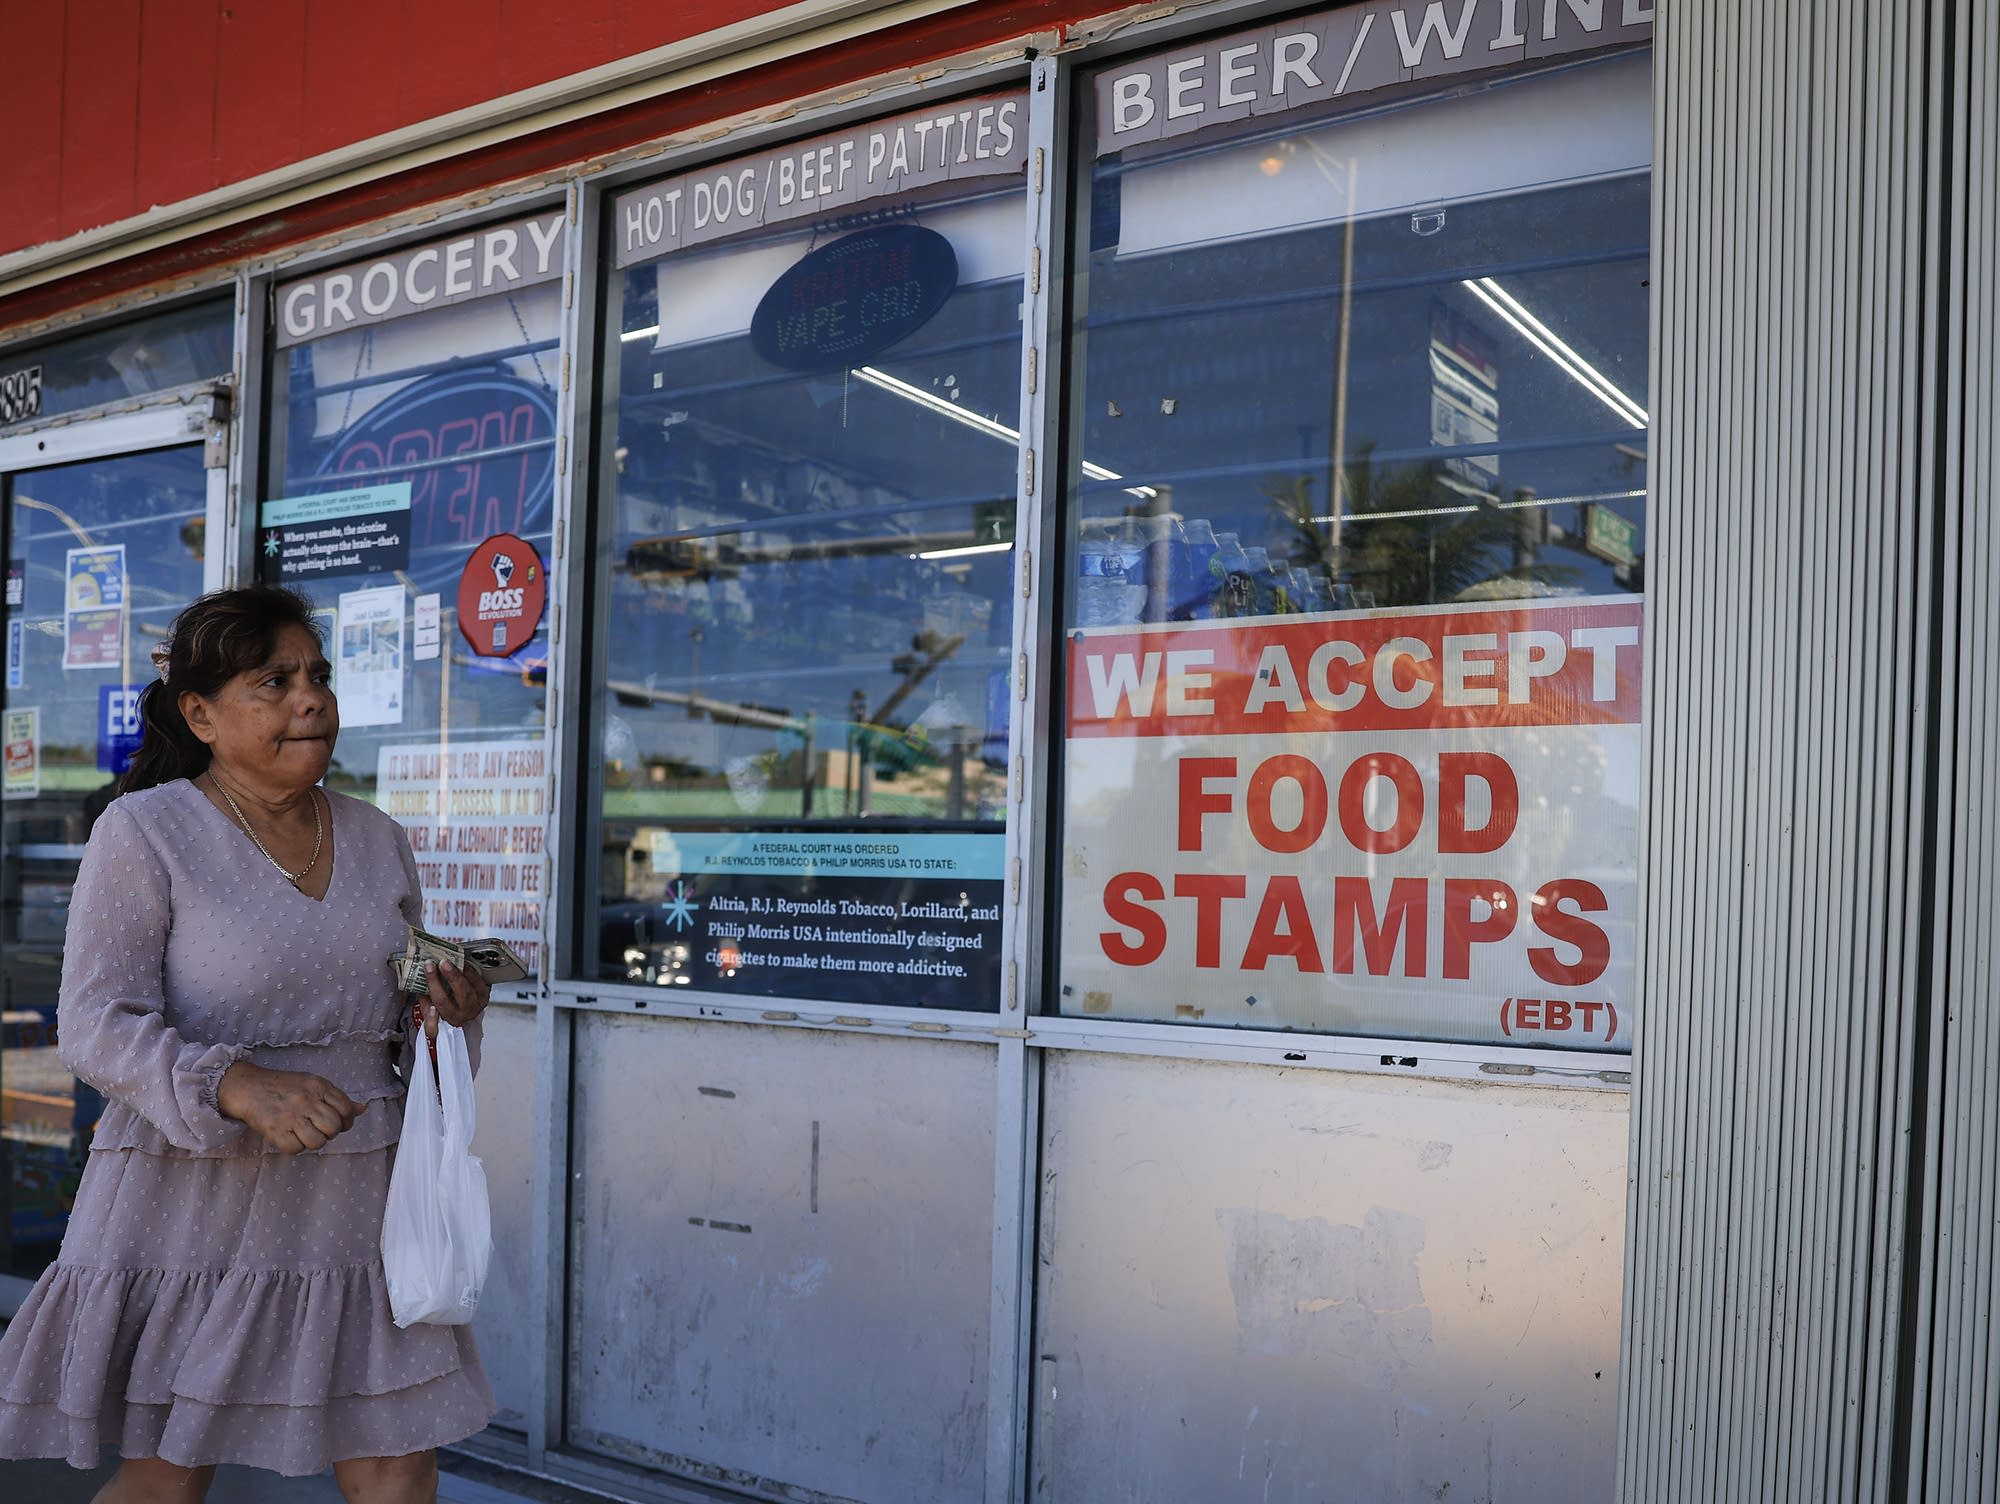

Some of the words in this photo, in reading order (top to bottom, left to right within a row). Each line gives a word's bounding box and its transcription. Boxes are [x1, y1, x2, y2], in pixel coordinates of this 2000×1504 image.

[1112, 0, 1653, 135] BEER/WIN
[627, 189, 682, 252] HOT
[868, 101, 1018, 183] PATTIES
[284, 215, 566, 338] GROCERY
[776, 299, 848, 351] VAPE
[861, 280, 922, 327] CBD
[0, 369, 41, 422] 895
[284, 532, 304, 543] When
[304, 532, 318, 543] you
[319, 527, 343, 540] smoke,
[344, 525, 356, 536] the
[357, 521, 387, 535] nicotine
[282, 545, 309, 558] actually
[310, 543, 338, 555] changes
[339, 541, 351, 551] the
[282, 562, 297, 573] why
[297, 557, 324, 573] quitting
[325, 557, 332, 566] is
[342, 554, 362, 566] hard.
[478, 588, 524, 612] BOSS
[478, 608, 523, 620] REVOLUTION
[1086, 648, 1215, 719] WE
[1243, 625, 1640, 715] ACCEPT
[107, 691, 142, 735] EB
[389, 755, 398, 780] IT
[400, 755, 409, 780] IS
[413, 753, 458, 780] UNLAWUL
[463, 752, 480, 779] FOR
[483, 751, 503, 778] ANY
[501, 789, 512, 816] IN
[515, 789, 529, 816] AN
[1178, 751, 1520, 855] FOOD
[457, 826, 508, 853] ALCOHOLIC
[753, 844, 760, 853] A
[761, 844, 799, 853] FEDERAL
[802, 844, 831, 853] COURT
[834, 844, 852, 854] HAS
[855, 845, 899, 854] ORDERED
[446, 863, 458, 889] OR
[462, 864, 496, 890] WITHIN
[500, 865, 517, 891] 100
[521, 865, 542, 891] FEE
[705, 856, 720, 865] R.J.
[722, 857, 766, 866] REYNOLDS
[768, 857, 809, 866] TOBACCO
[812, 858, 818, 866] &
[820, 858, 848, 867] PHILIP
[850, 858, 885, 868] MORRIS
[888, 859, 907, 868] USA
[909, 859, 921, 868] TO
[924, 860, 956, 869] STATE:
[431, 899, 450, 926] THIS
[489, 901, 541, 930] VIOLATORS
[709, 896, 749, 914] Altria,
[751, 897, 774, 914] R.J.
[777, 898, 837, 917] Reynolds
[839, 900, 898, 920] Tobacco,
[901, 902, 968, 922] Lorillard,
[971, 905, 999, 921] and
[708, 922, 745, 941] Philip
[748, 923, 790, 940] Morris
[793, 926, 823, 942] USA
[826, 927, 915, 949] intentionally
[917, 931, 982, 952] designed
[1099, 871, 1612, 987] STAMPS
[705, 948, 765, 967] cigarettes
[767, 953, 780, 966] to
[782, 953, 818, 969] make
[821, 954, 856, 971] them
[858, 960, 895, 973] more
[897, 958, 968, 978] addictive.
[1499, 997, 1618, 1042] (EBT)
